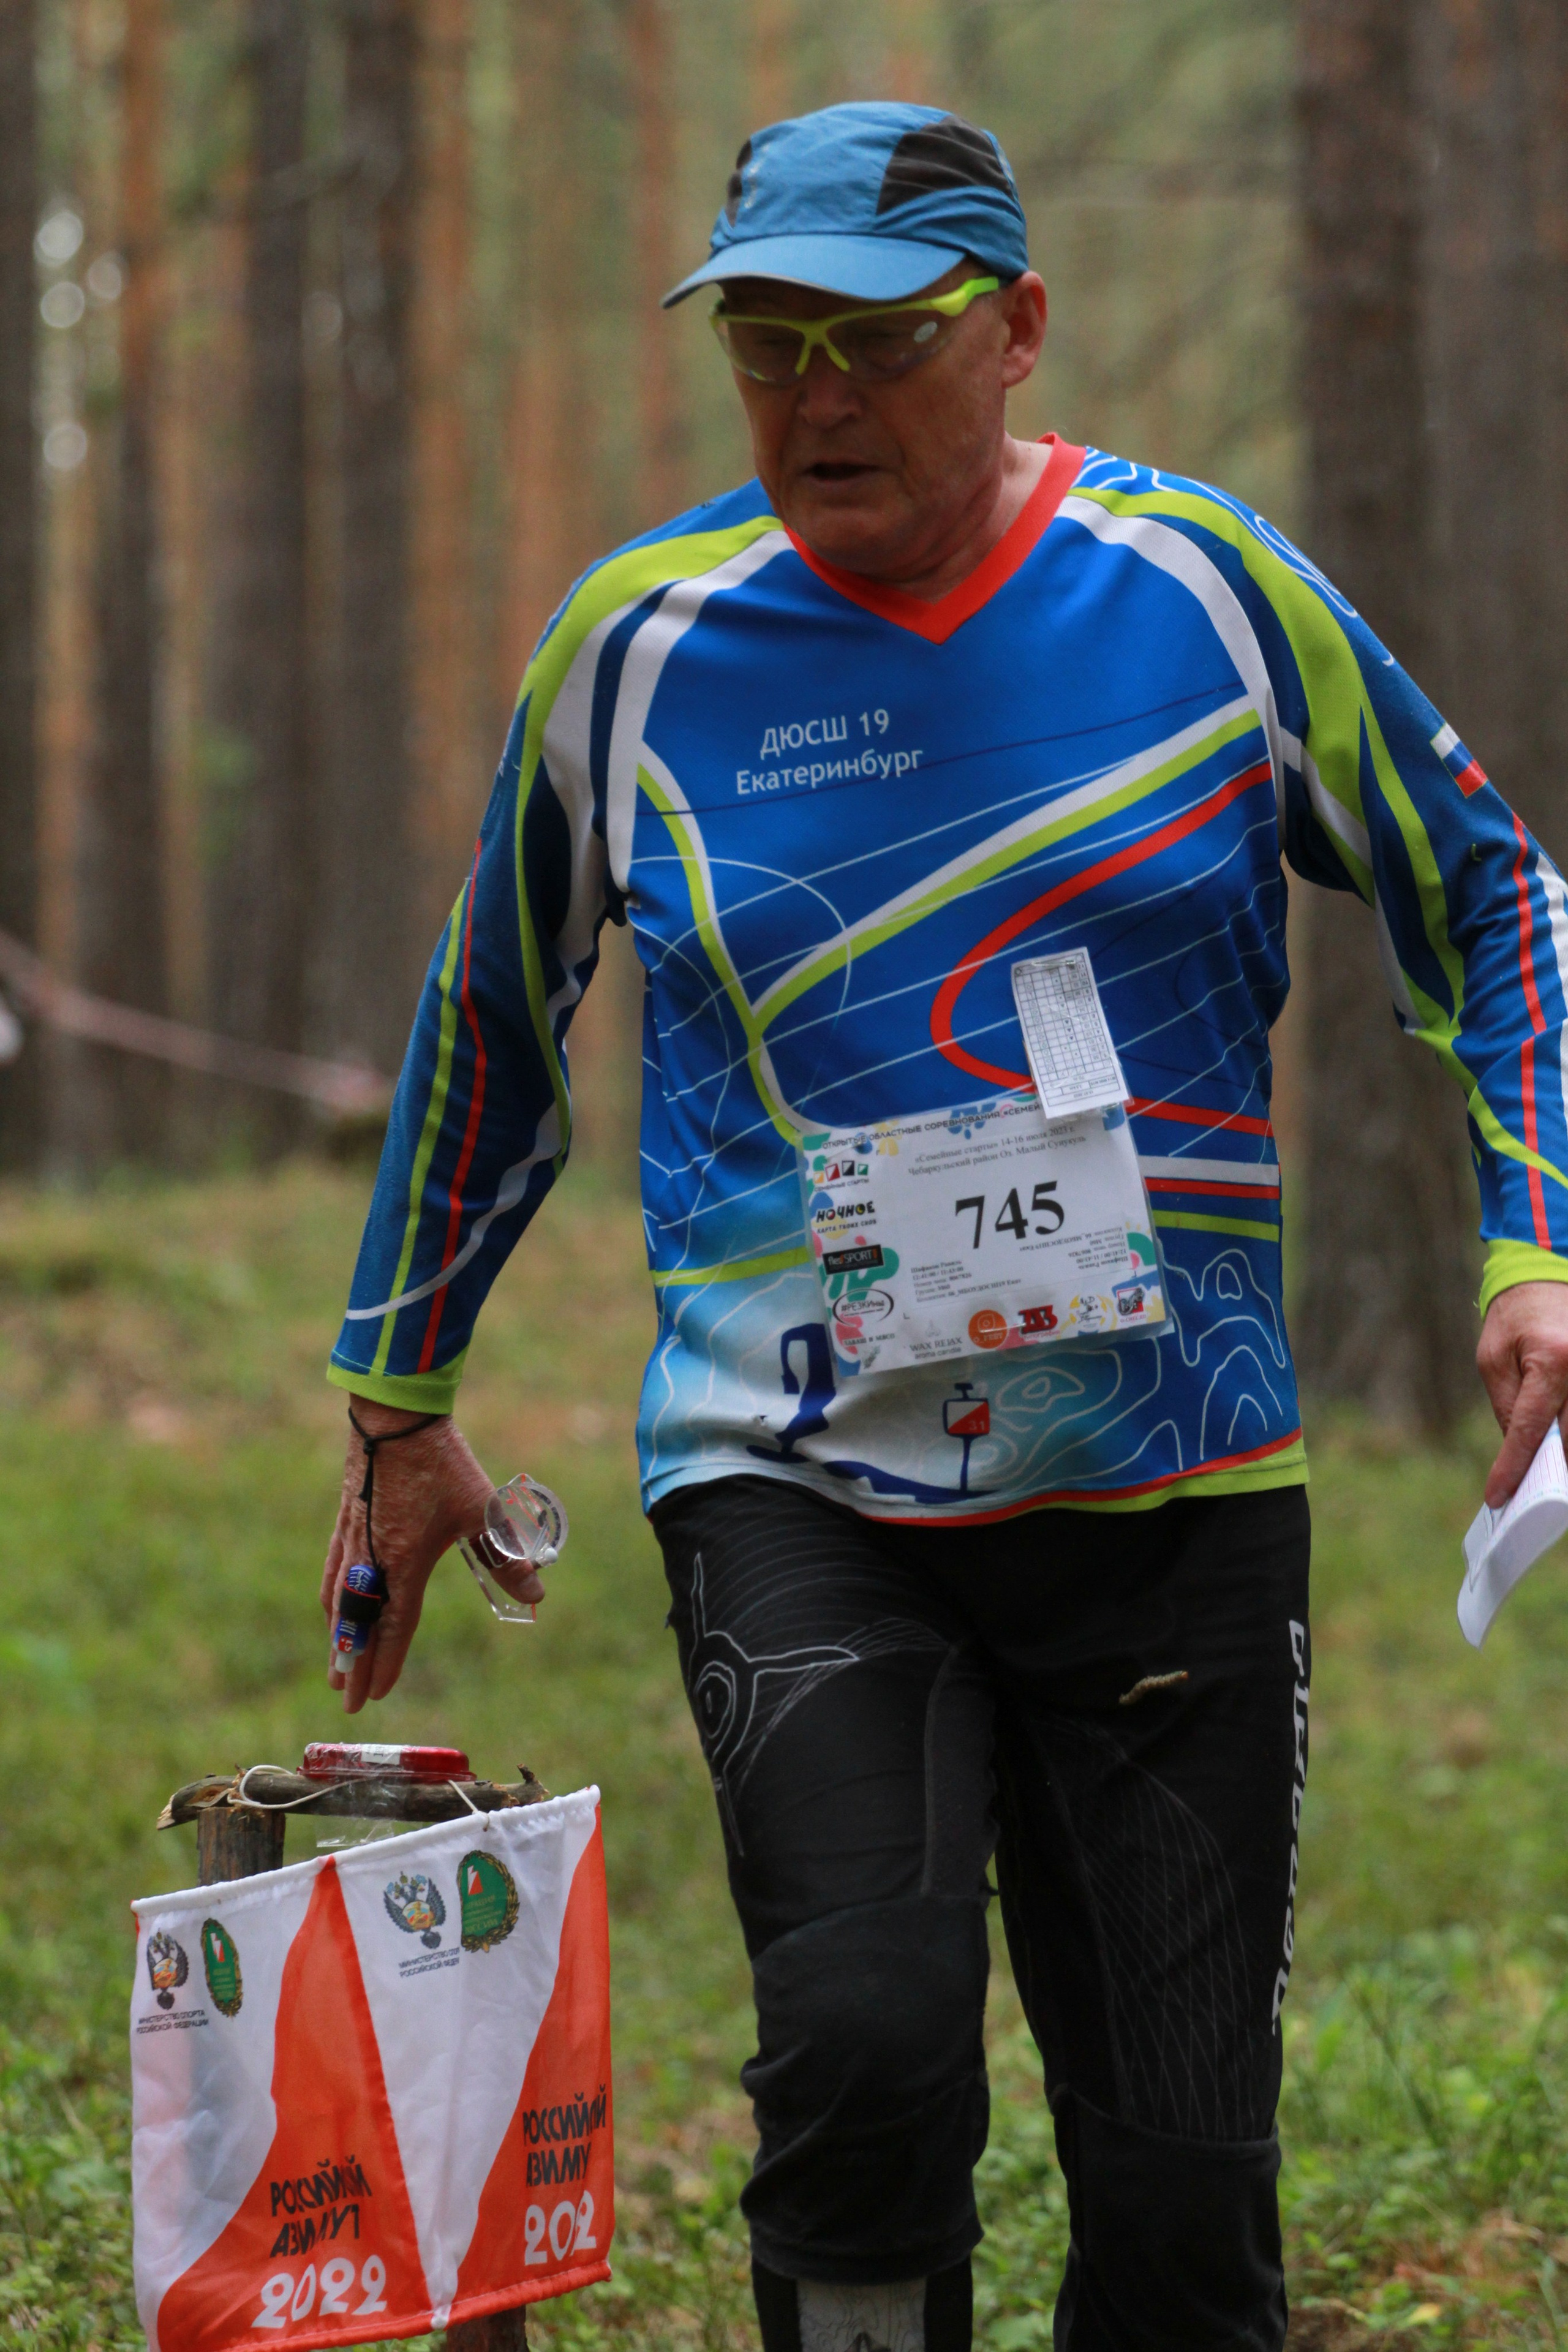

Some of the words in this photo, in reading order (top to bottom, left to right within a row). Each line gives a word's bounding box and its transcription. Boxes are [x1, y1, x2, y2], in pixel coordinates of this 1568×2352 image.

[760, 715, 848, 760] ДЮСШ
[859, 709, 889, 736] 19
[736, 748, 923, 795] Екатеринбург
[869, 1126, 921, 1141] ОБЛАСТНЫЕ
[924, 1112, 1000, 1131] СОРЕВНОВАНИЯ
[1001, 1135, 1024, 1147] 14-16
[816, 1201, 875, 1223] НОЧНОЕ
[956, 1180, 1065, 1250] 745
[251, 2254, 388, 2329] 2022
